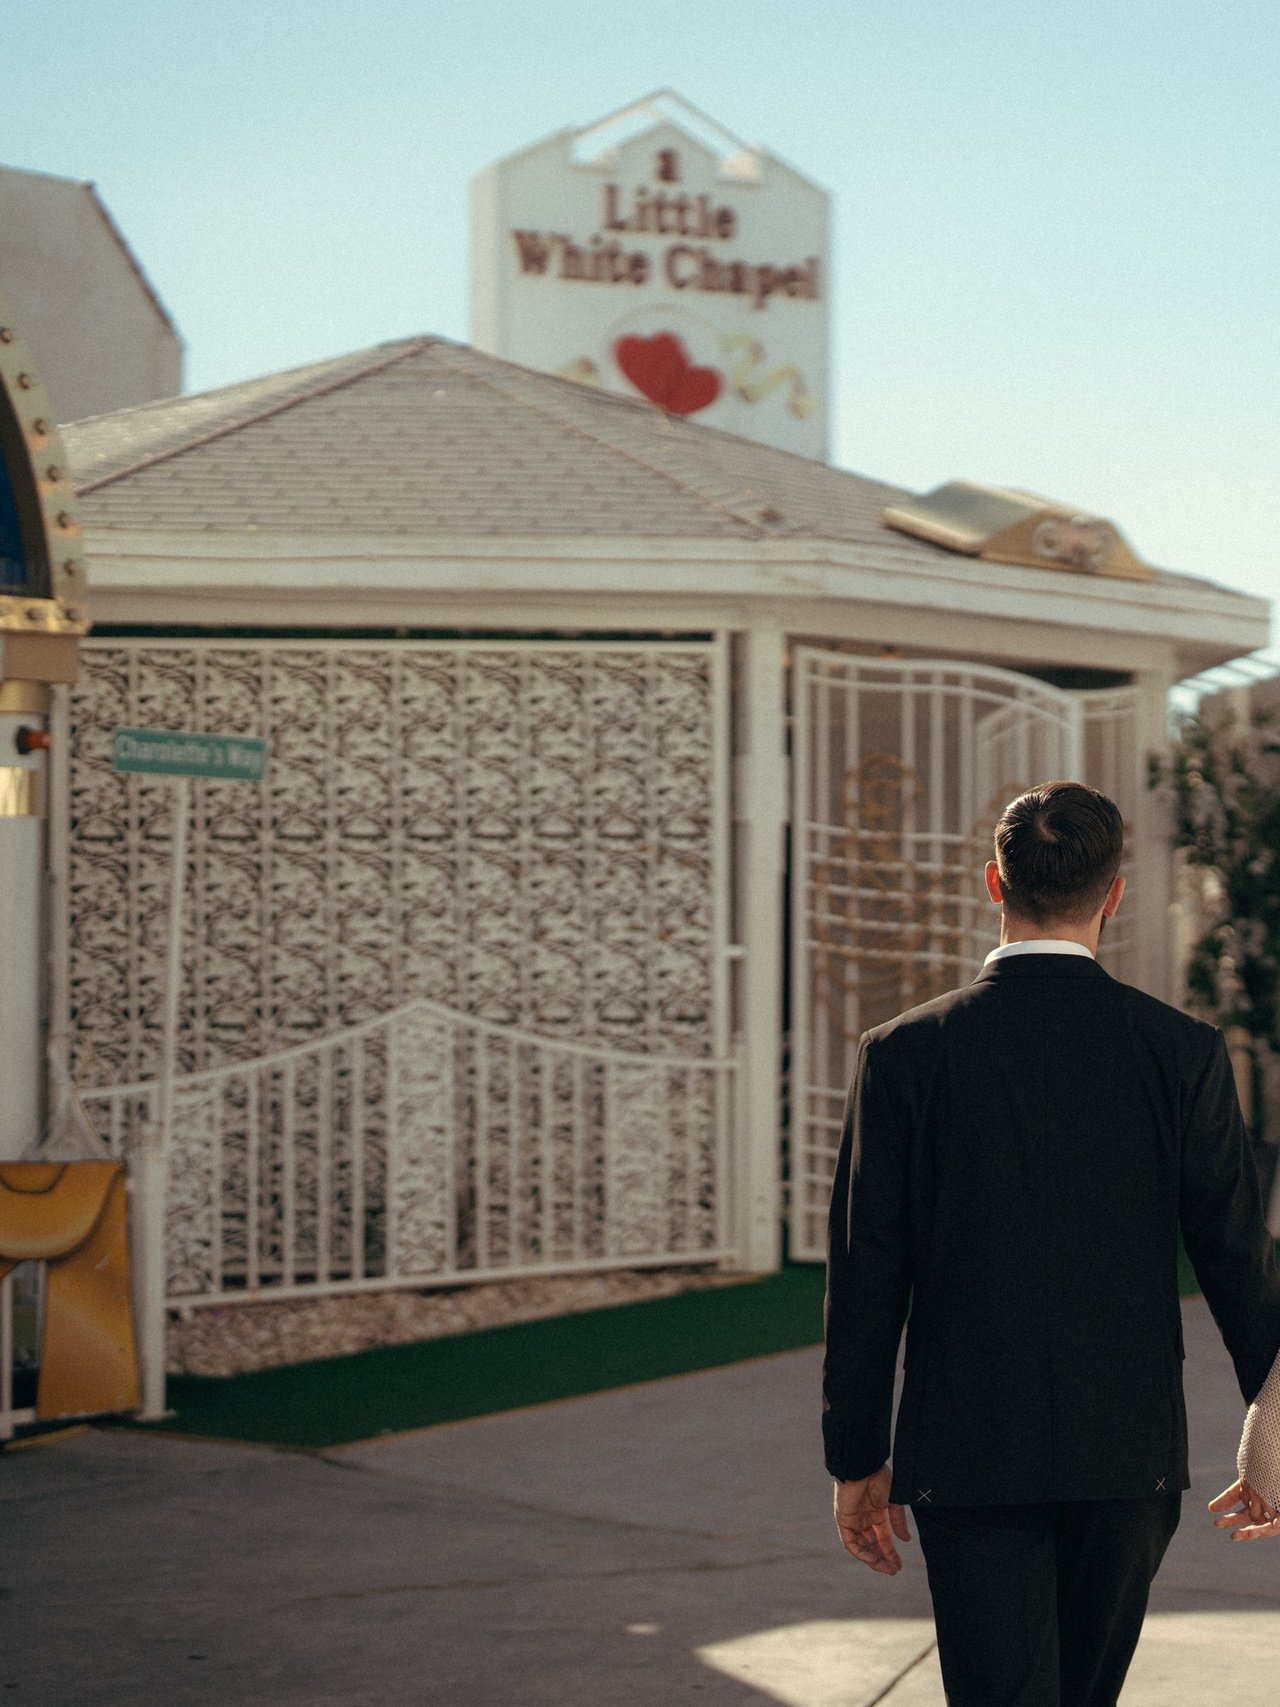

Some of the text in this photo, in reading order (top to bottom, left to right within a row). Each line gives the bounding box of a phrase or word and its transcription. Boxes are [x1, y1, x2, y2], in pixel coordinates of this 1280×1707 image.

[604, 183, 737, 241] Little
[511, 229, 819, 311] White Chapel
